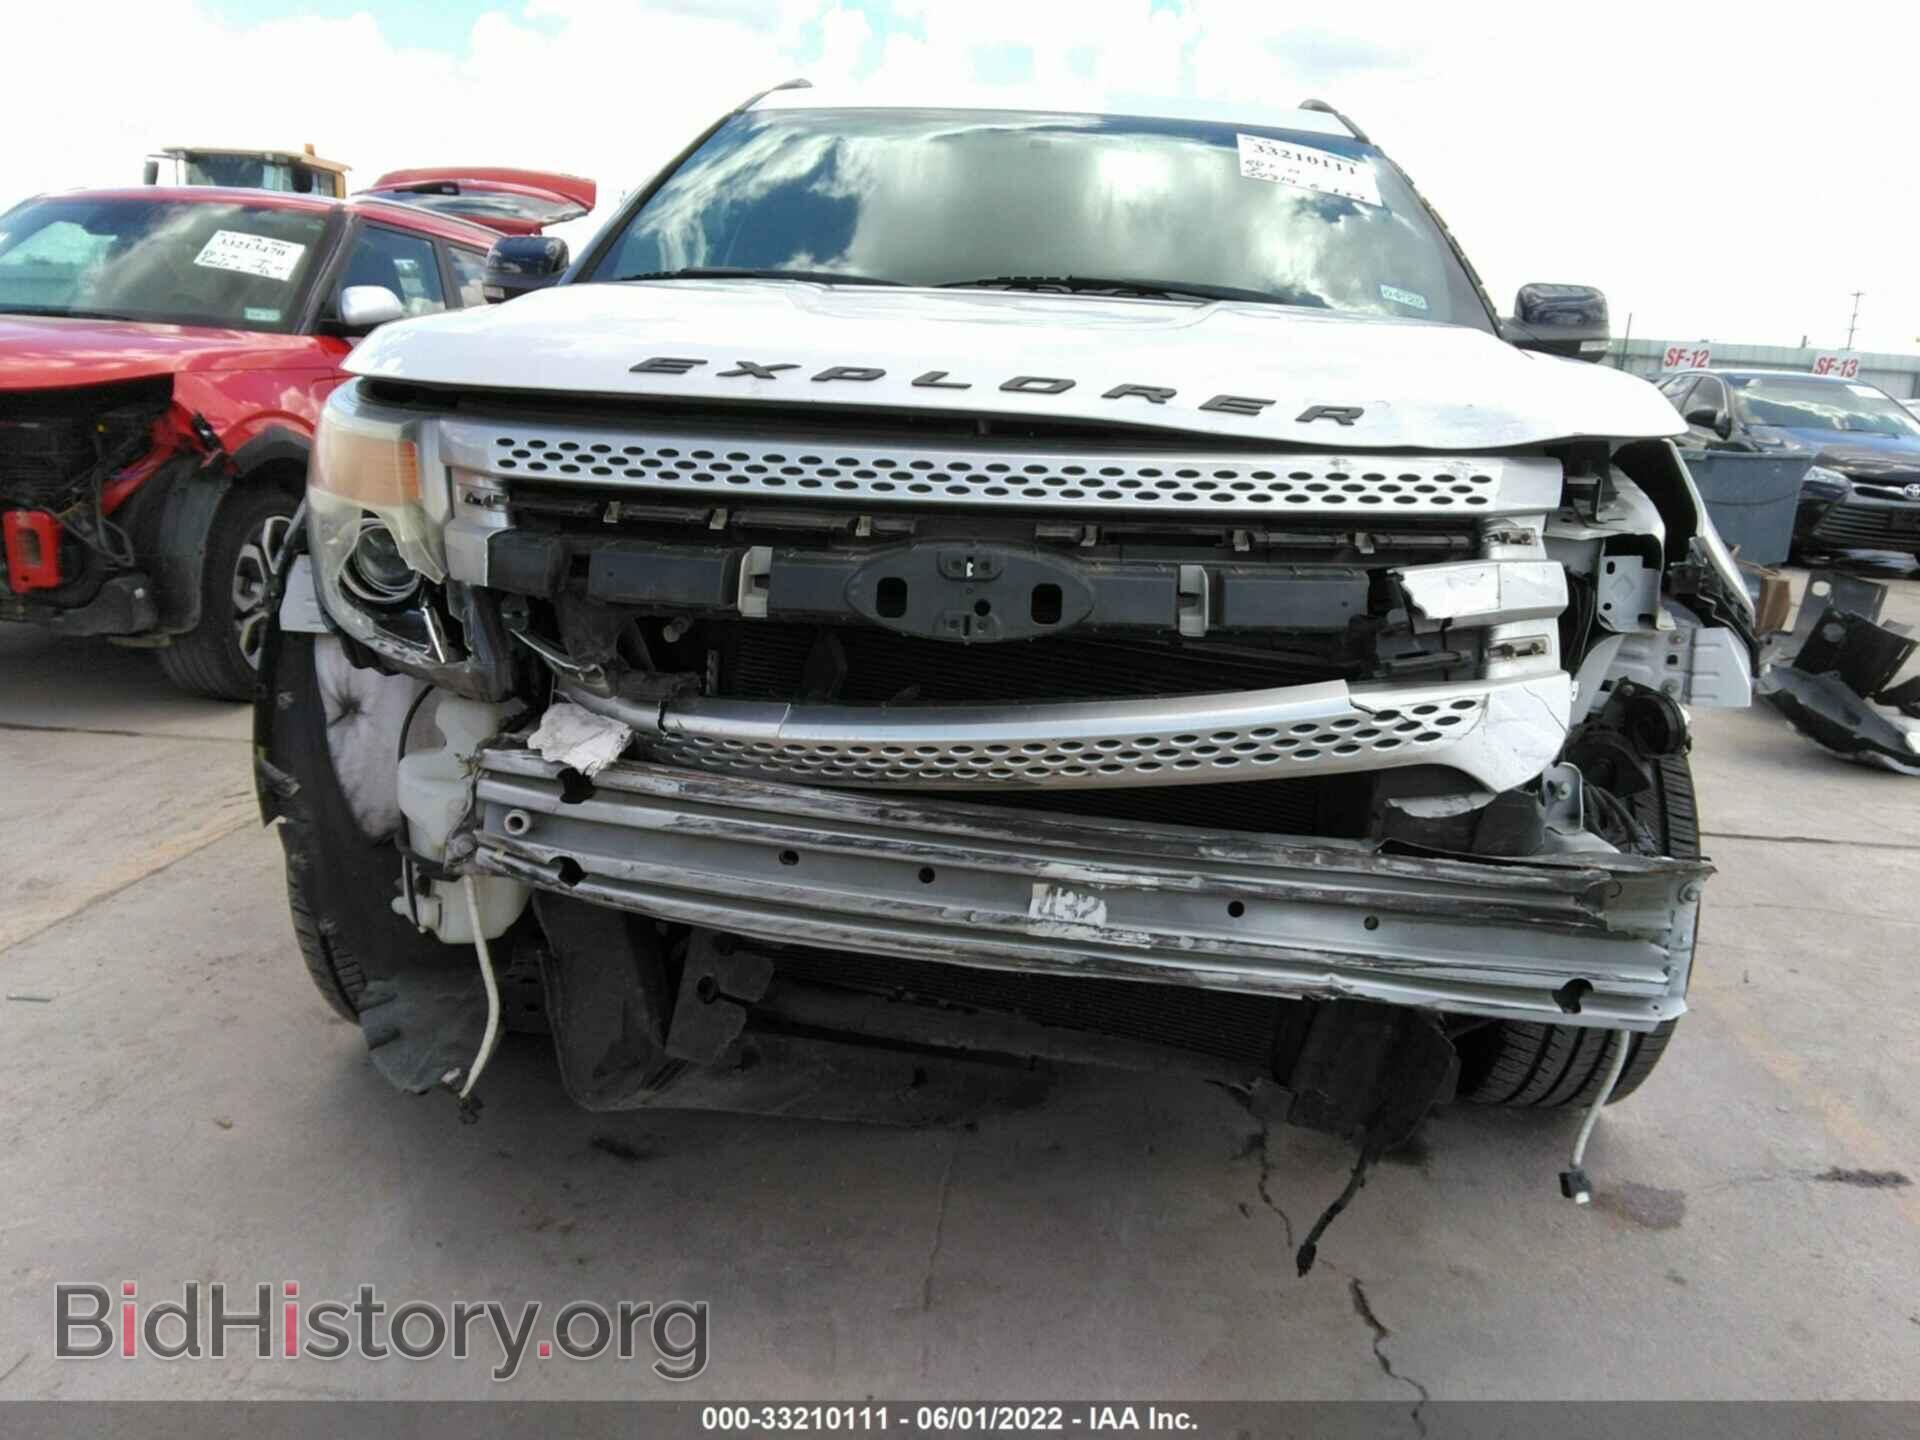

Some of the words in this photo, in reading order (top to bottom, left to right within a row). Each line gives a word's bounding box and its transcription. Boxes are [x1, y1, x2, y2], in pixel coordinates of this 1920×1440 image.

[1253, 142, 1355, 175] 33210111
[1664, 347, 1710, 368] SF-12
[1814, 357, 1859, 377] SF-13
[628, 356, 1365, 427] EXPLORER
